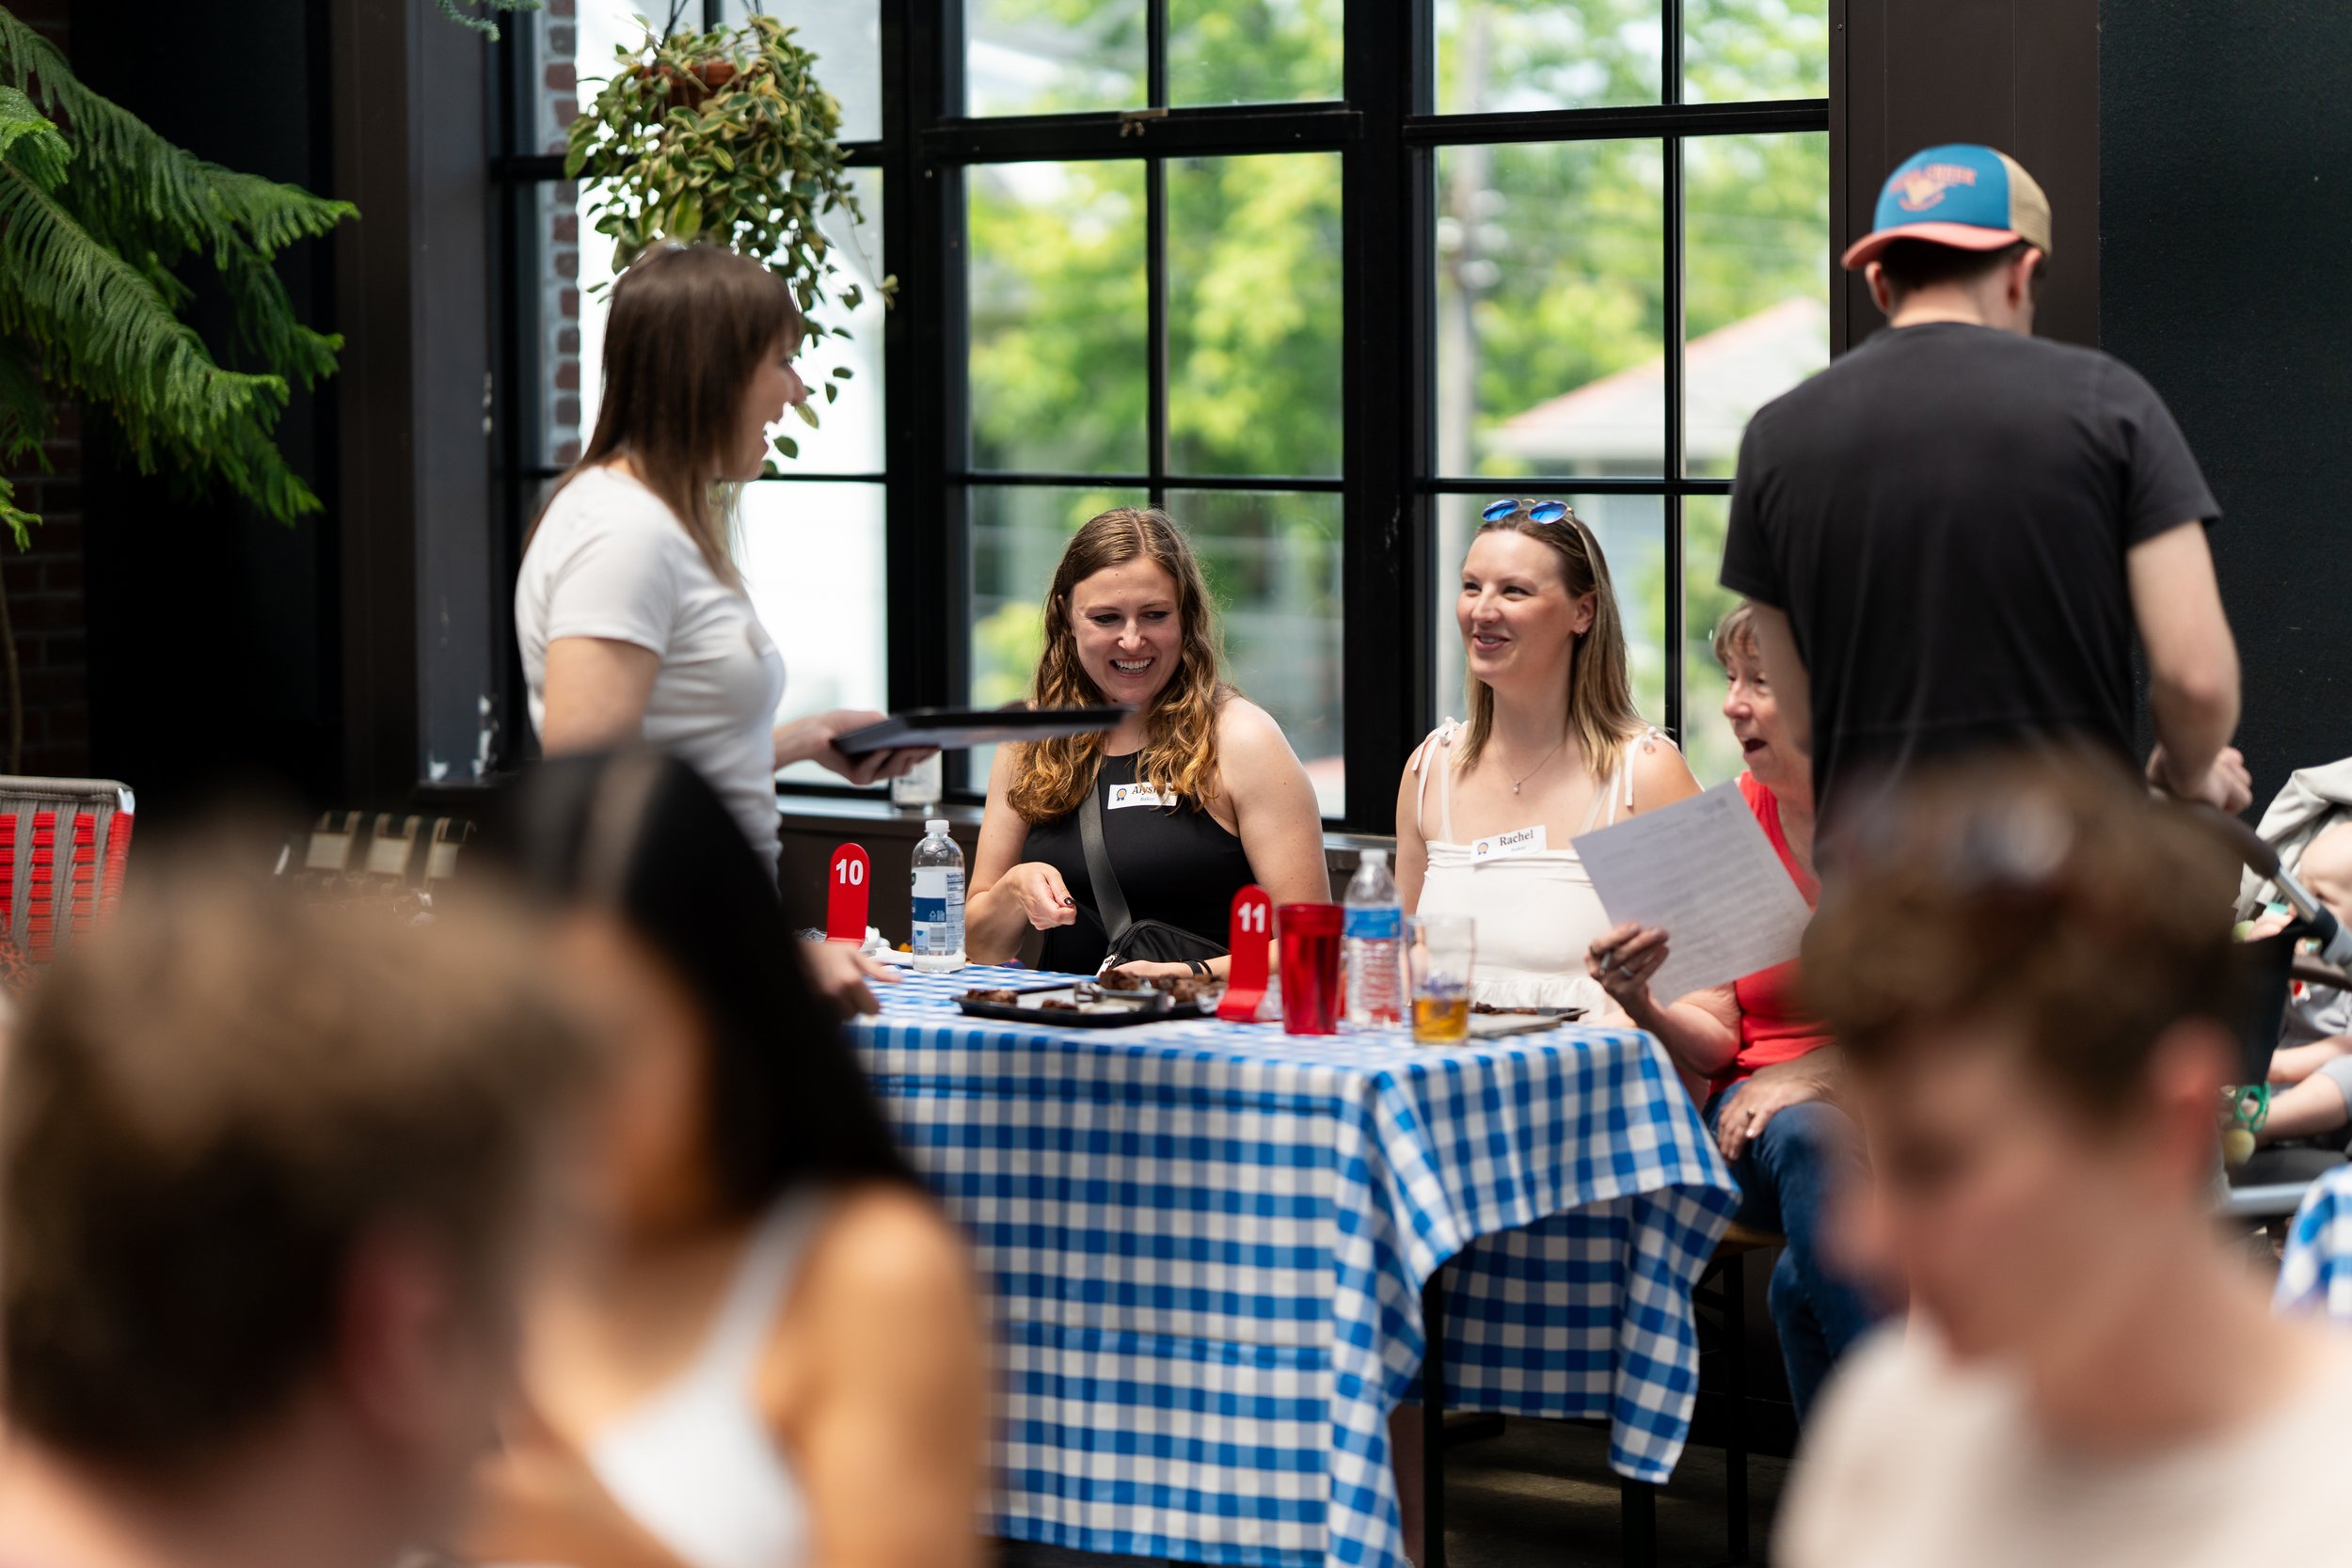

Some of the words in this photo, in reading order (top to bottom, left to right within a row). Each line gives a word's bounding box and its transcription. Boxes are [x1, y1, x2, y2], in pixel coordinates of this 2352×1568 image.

[1500, 829, 1534, 846] Rachel
[836, 858, 864, 886] 10
[1237, 901, 1265, 933] 11
